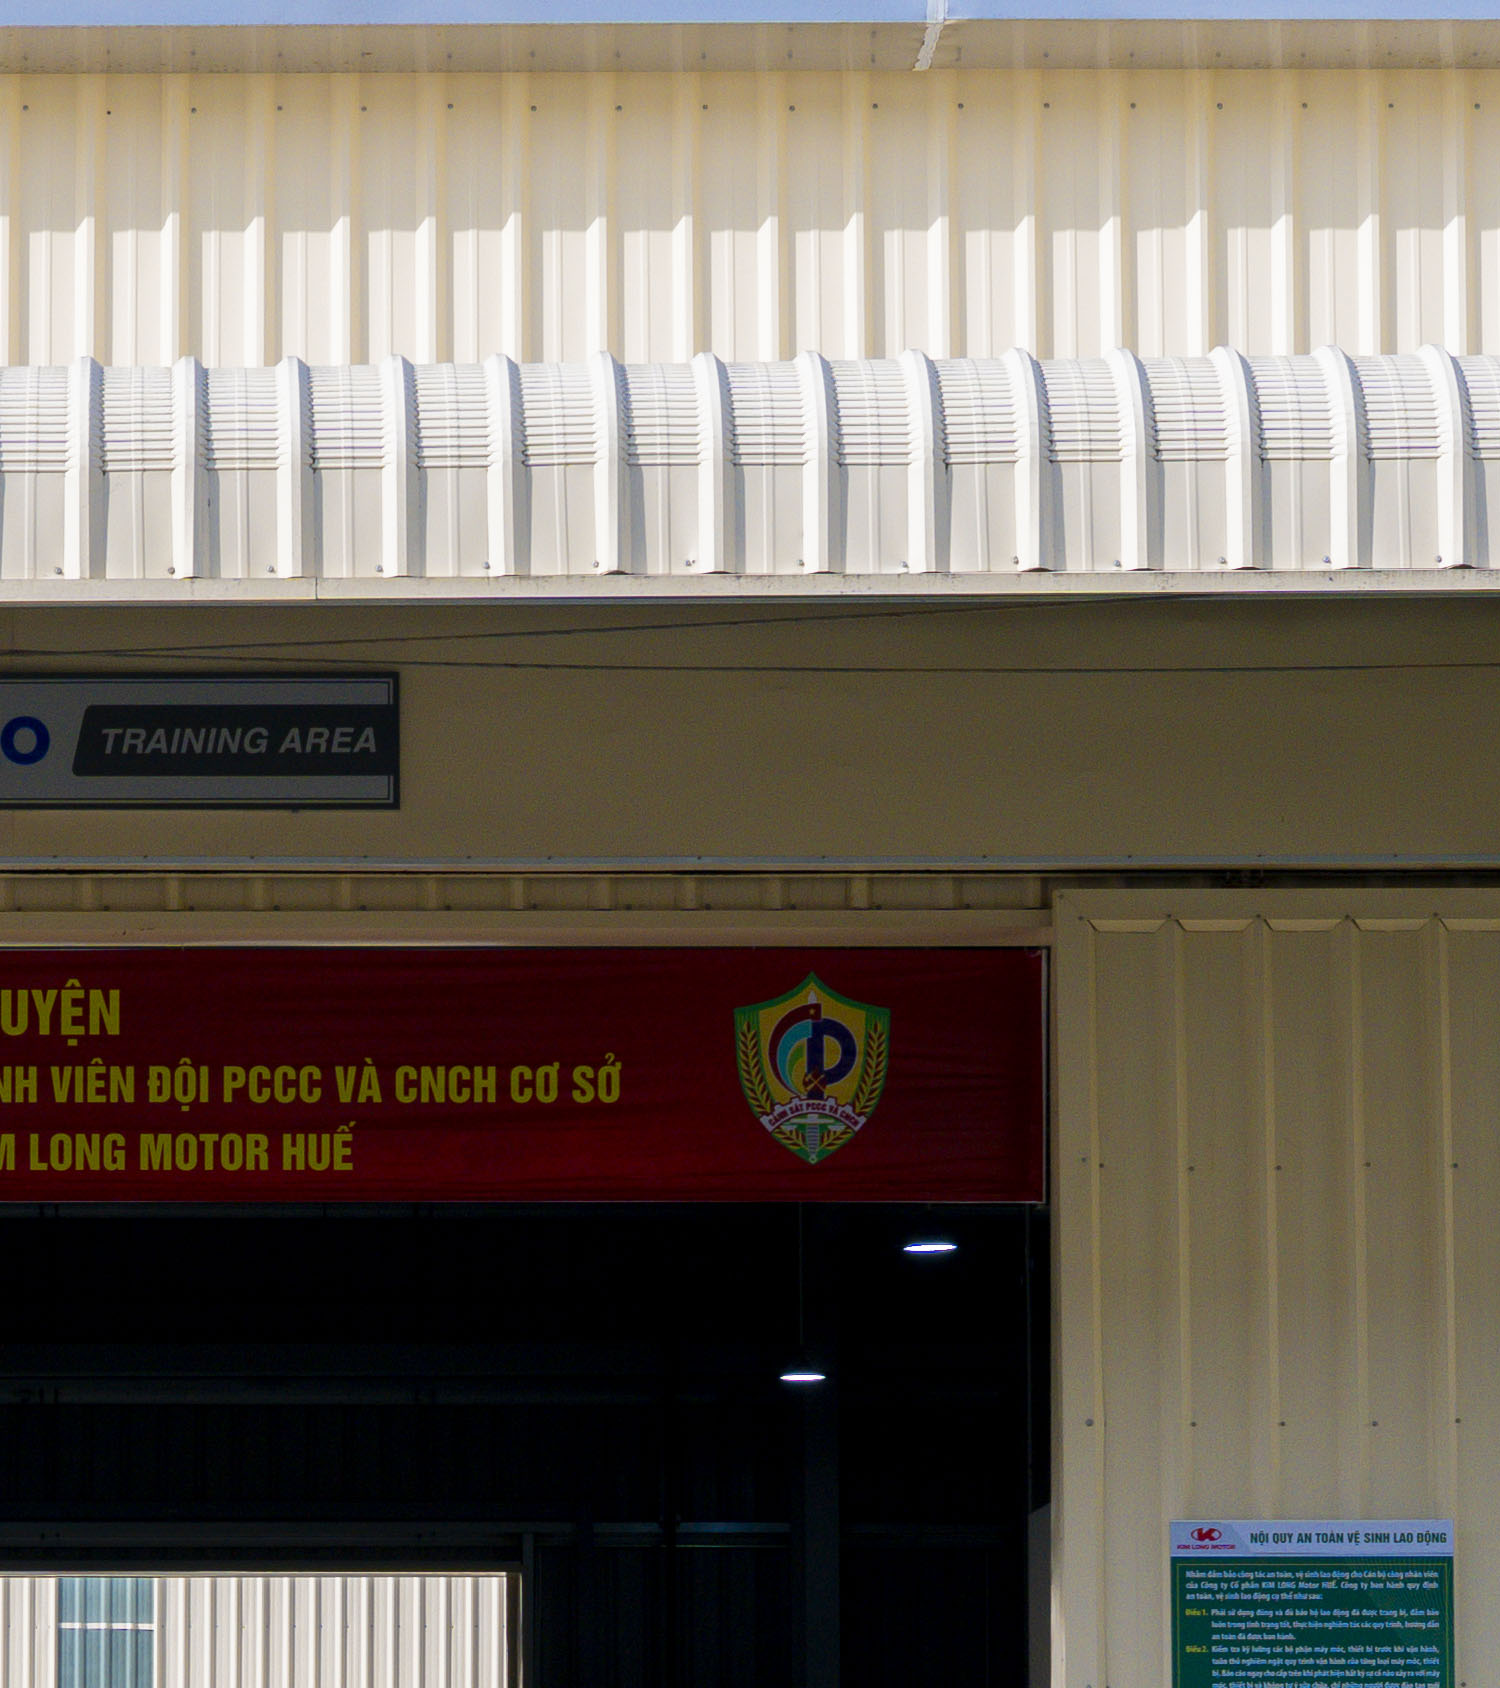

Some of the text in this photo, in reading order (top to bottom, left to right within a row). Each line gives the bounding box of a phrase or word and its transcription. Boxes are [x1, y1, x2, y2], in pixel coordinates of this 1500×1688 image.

[102, 727, 376, 754] TRAINING AREA
[50, 1057, 135, 1103] VIÊN
[147, 1057, 209, 1111] ĐỘI
[223, 1065, 322, 1103] PCCC
[335, 1057, 382, 1103] VÀ
[395, 1065, 496, 1103] CNCH
[510, 1062, 560, 1103] CƠ
[572, 1052, 622, 1103] SỞ
[30, 1133, 125, 1171] LONG
[140, 1133, 269, 1171] MOTOR
[283, 1121, 356, 1171] HUẾ
[1250, 1530, 1447, 1546] NỘI QUY AN TOÀN VỆ SINH LAO ĐỘNG
